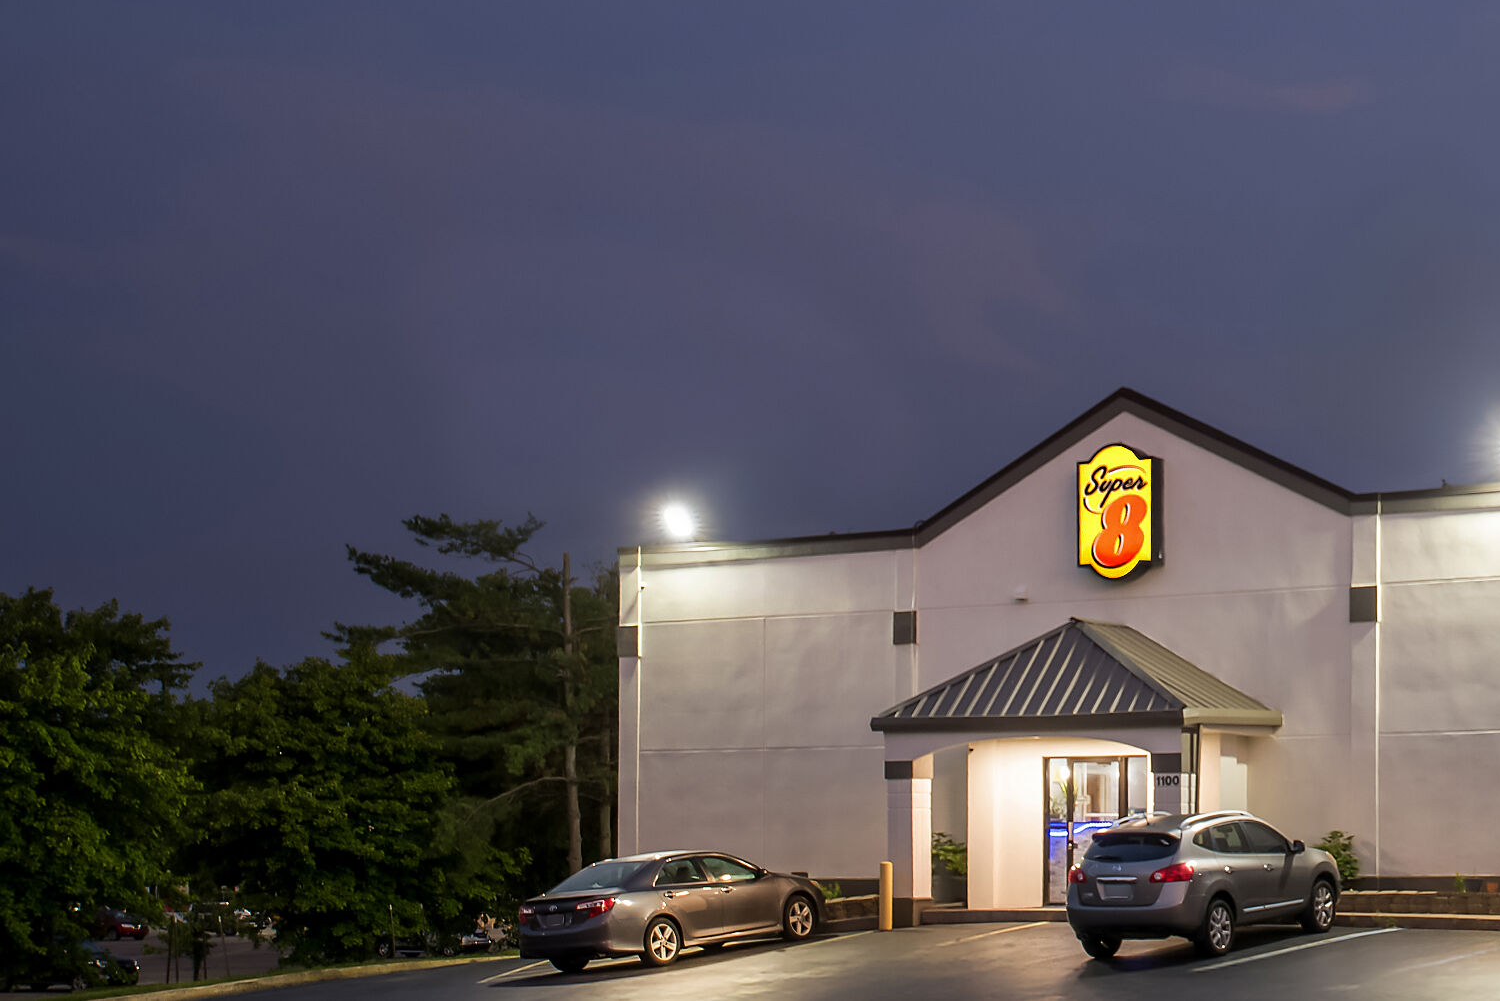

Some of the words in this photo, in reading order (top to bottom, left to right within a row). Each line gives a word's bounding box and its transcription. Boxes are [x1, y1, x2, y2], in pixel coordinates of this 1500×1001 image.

[1084, 465, 1148, 508] Super
[1091, 494, 1147, 569] 8
[1156, 775, 1180, 786] 1100
